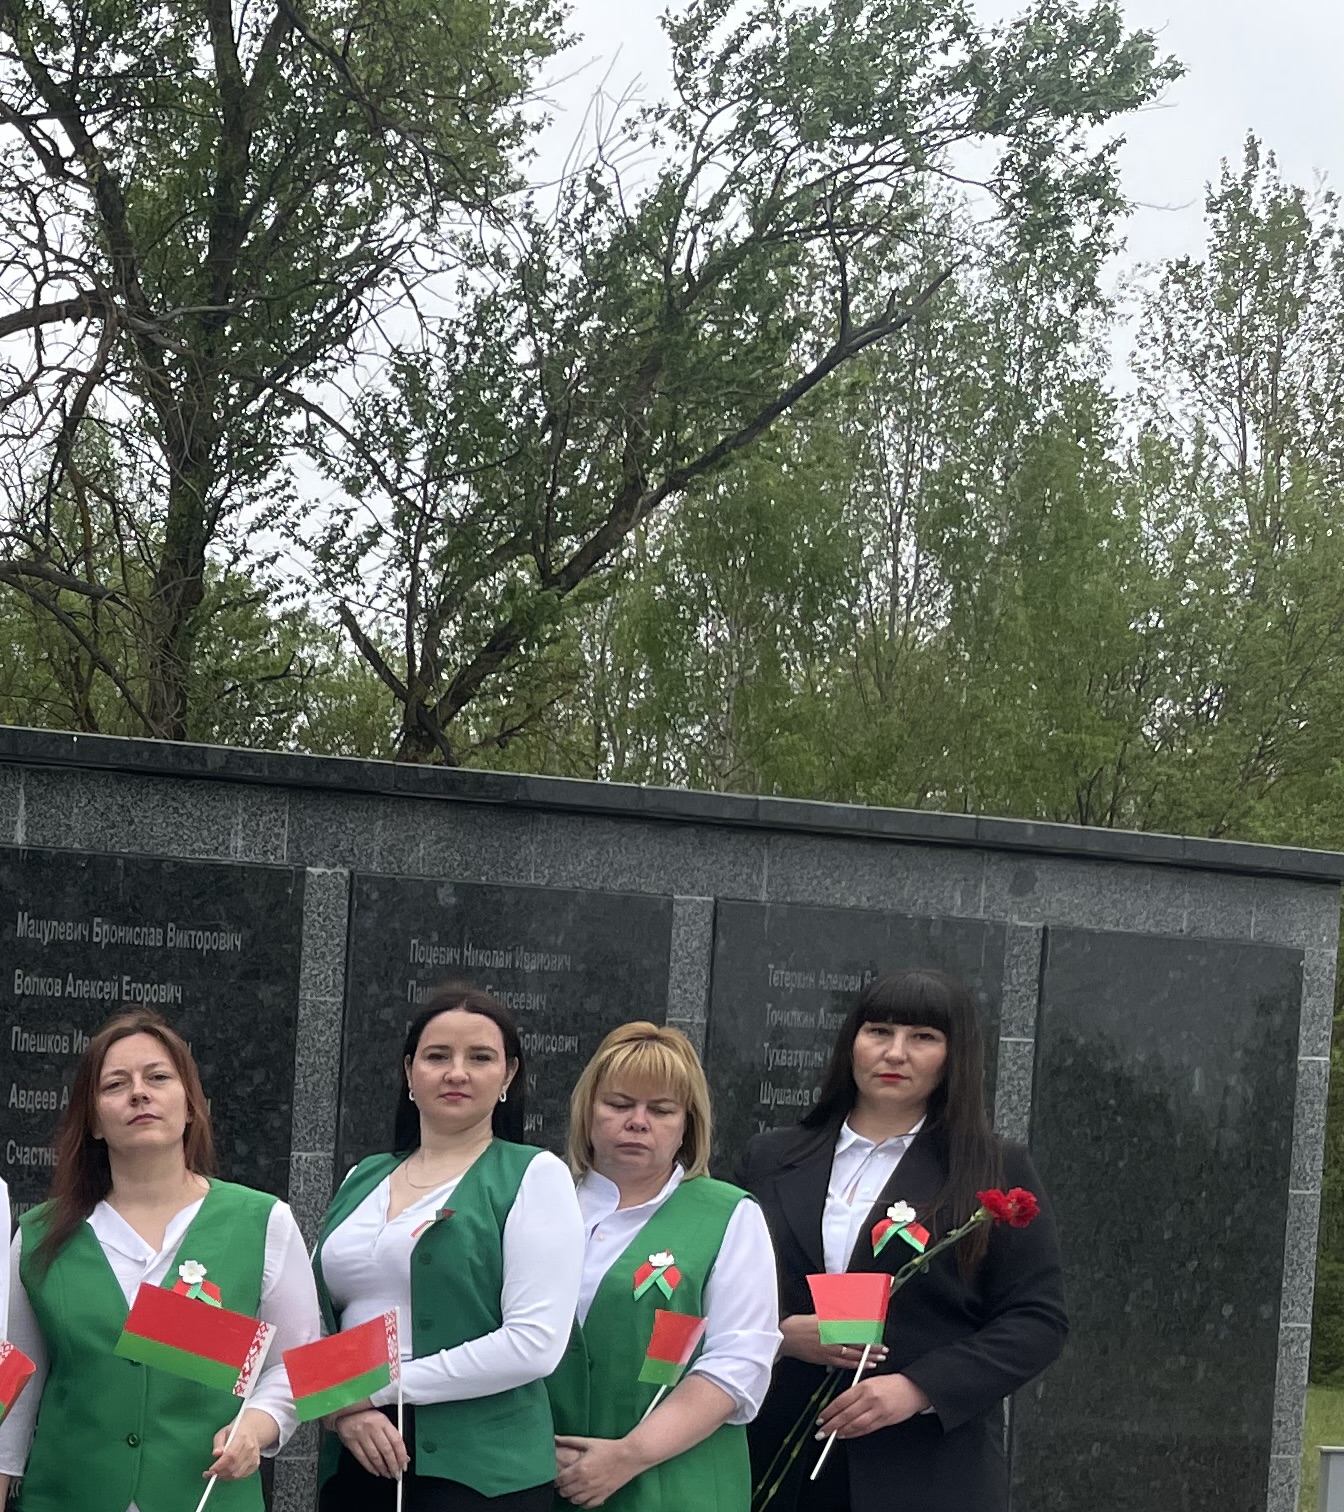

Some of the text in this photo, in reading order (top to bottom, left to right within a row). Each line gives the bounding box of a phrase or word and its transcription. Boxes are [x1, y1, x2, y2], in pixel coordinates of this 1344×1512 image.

[16, 911, 242, 956] Мацулевич Бронислав Викторович
[463, 942, 512, 969] Николай
[14, 969, 183, 1008] Волков Алексей Егорович
[11, 1026, 70, 1054] Плешков
[8, 1083, 57, 1113] Авдеев
